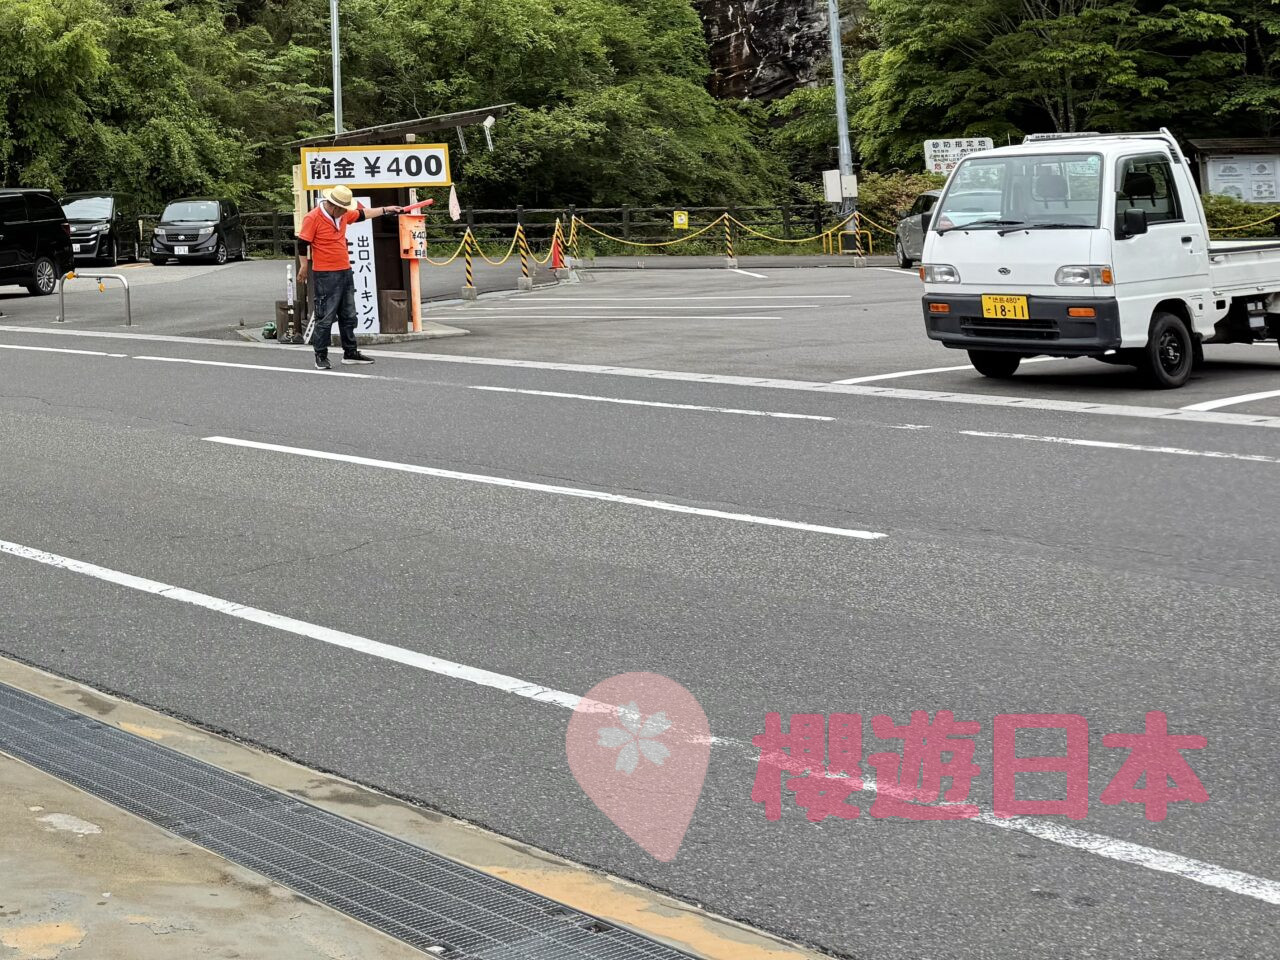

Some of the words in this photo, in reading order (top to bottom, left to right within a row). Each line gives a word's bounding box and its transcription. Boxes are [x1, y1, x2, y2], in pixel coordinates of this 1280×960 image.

[310, 157, 355, 180] 前金
[363, 154, 443, 178] ¥400
[357, 235, 375, 330] 出口パーキング
[994, 304, 1024, 318] 18-11
